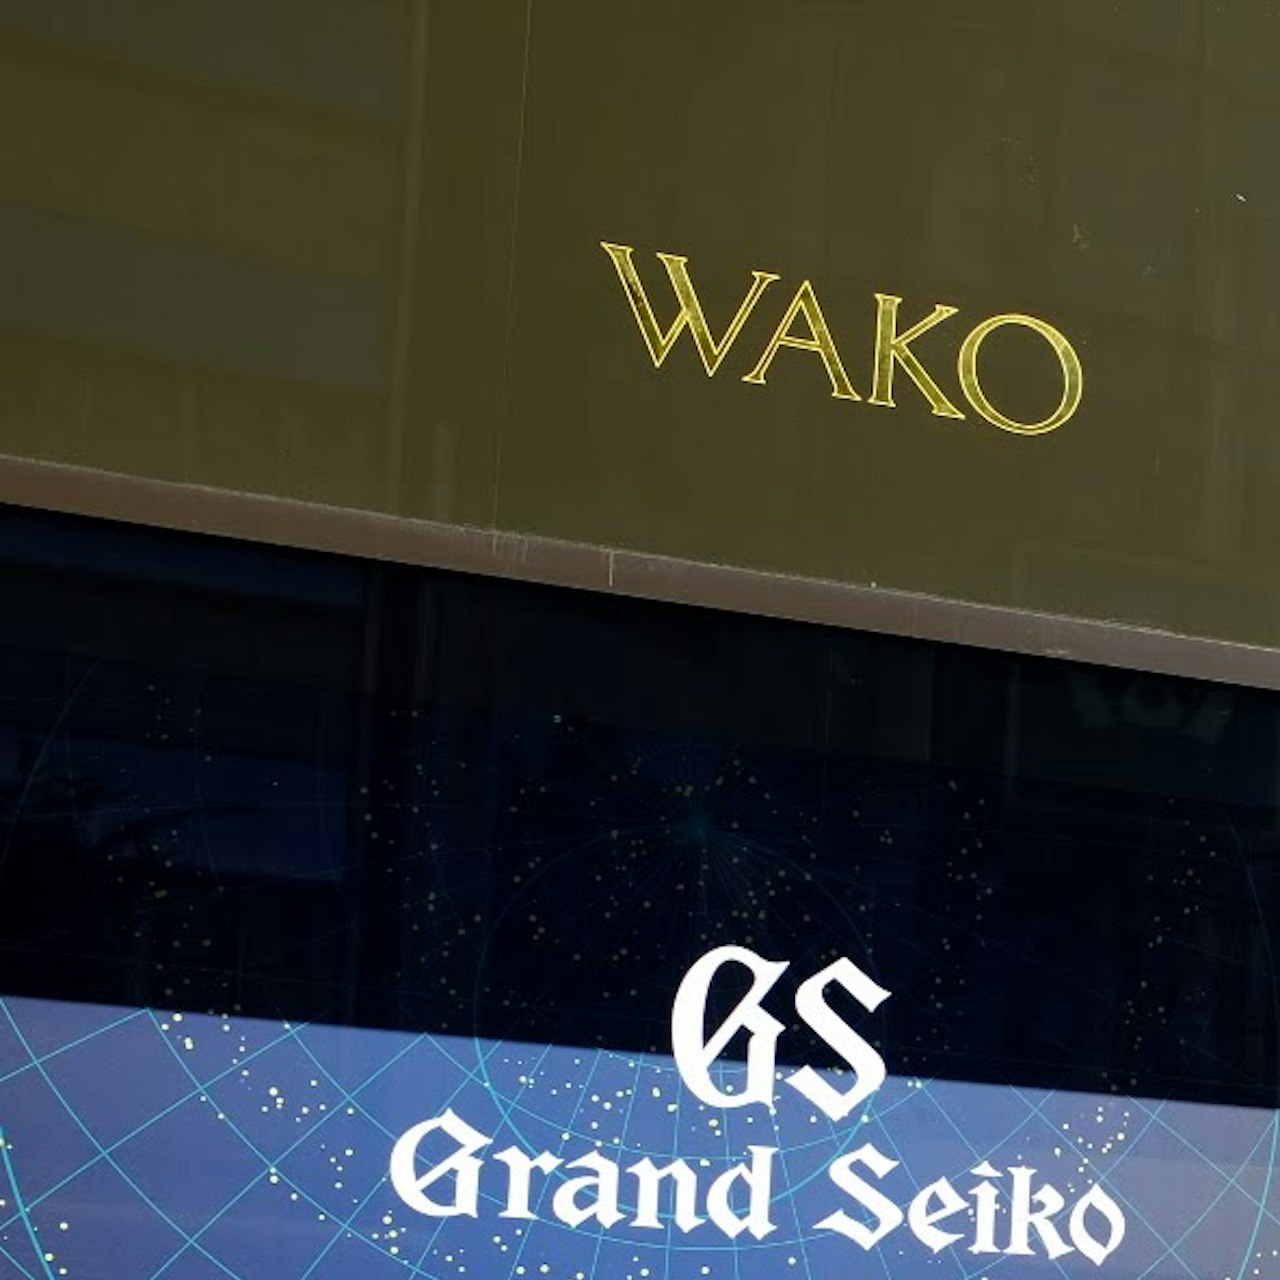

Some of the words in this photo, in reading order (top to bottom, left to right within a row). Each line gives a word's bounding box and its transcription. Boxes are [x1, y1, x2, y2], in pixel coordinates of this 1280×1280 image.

[600, 241, 1085, 436] WAKO
[671, 945, 893, 1122] GS
[388, 1106, 778, 1241] Grand
[812, 1142, 1127, 1267] Seiko
